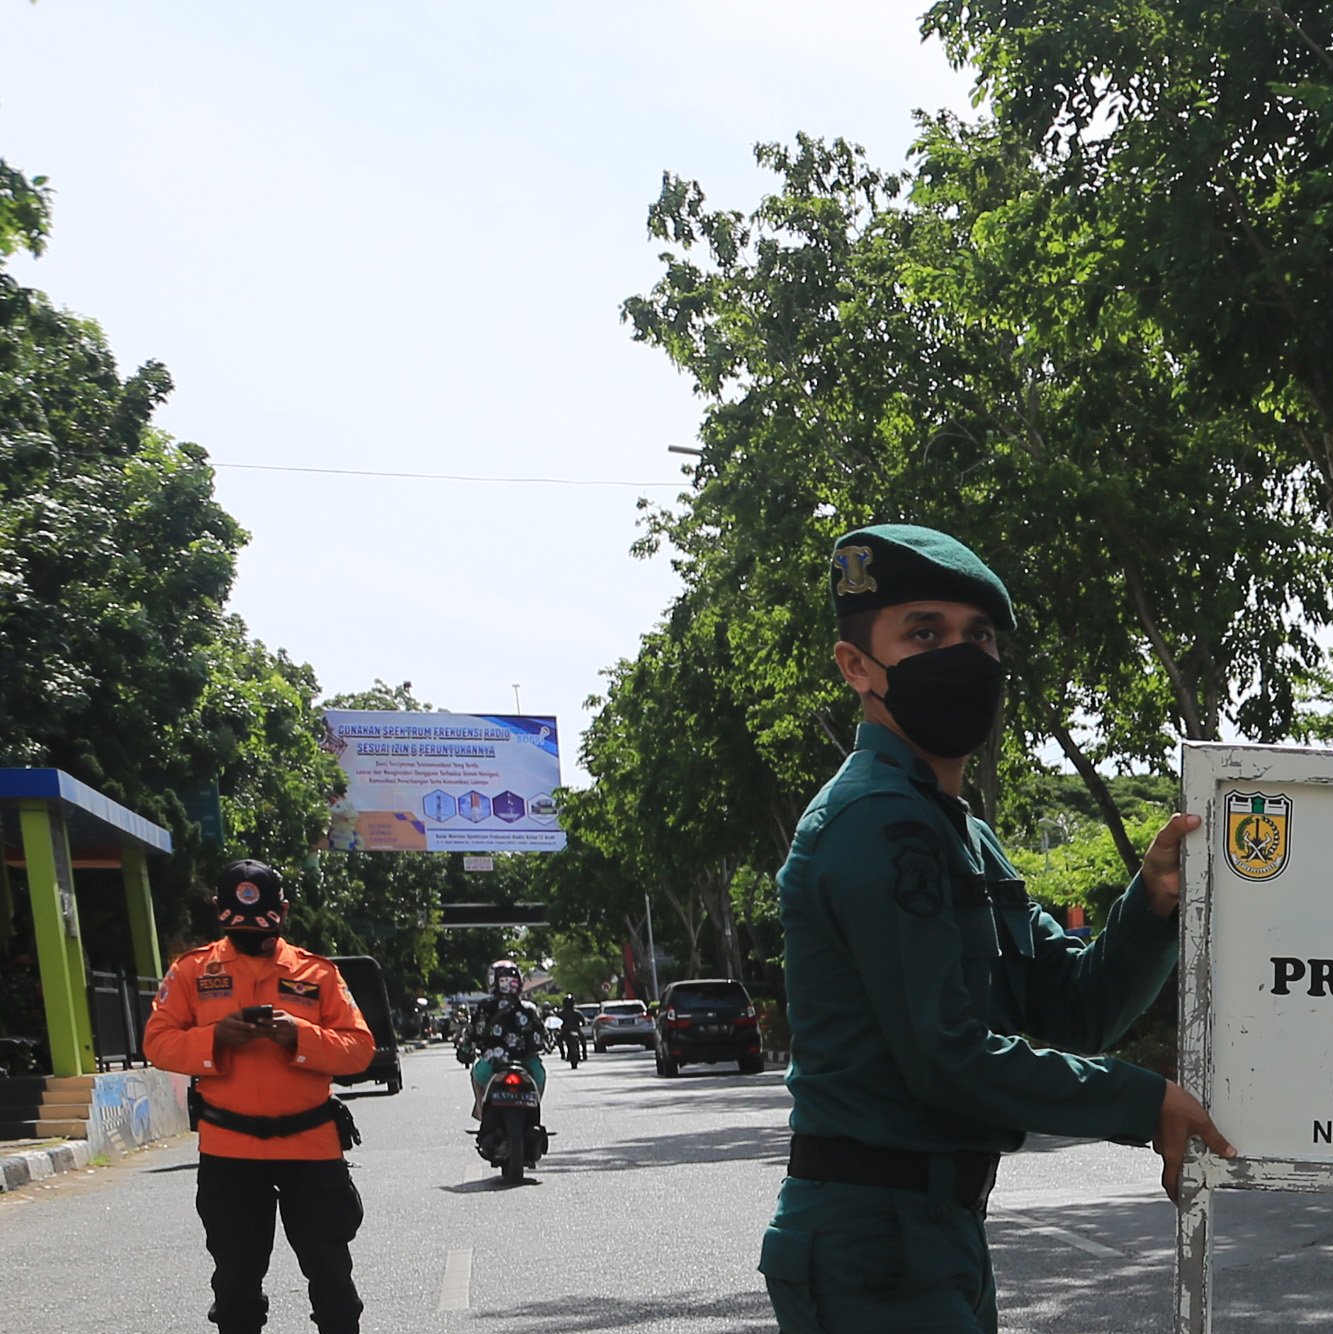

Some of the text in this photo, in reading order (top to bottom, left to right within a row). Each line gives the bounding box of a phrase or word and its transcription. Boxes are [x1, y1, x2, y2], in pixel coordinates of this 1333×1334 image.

[338, 724, 510, 741] GUNAKAN SPEKTRUM FREKUENSI RADIO
[357, 743, 390, 756] SESUAI
[391, 743, 409, 756] IZIN
[418, 744, 496, 758] PERUNTUKANNYA
[199, 977, 230, 988] RESCUE
